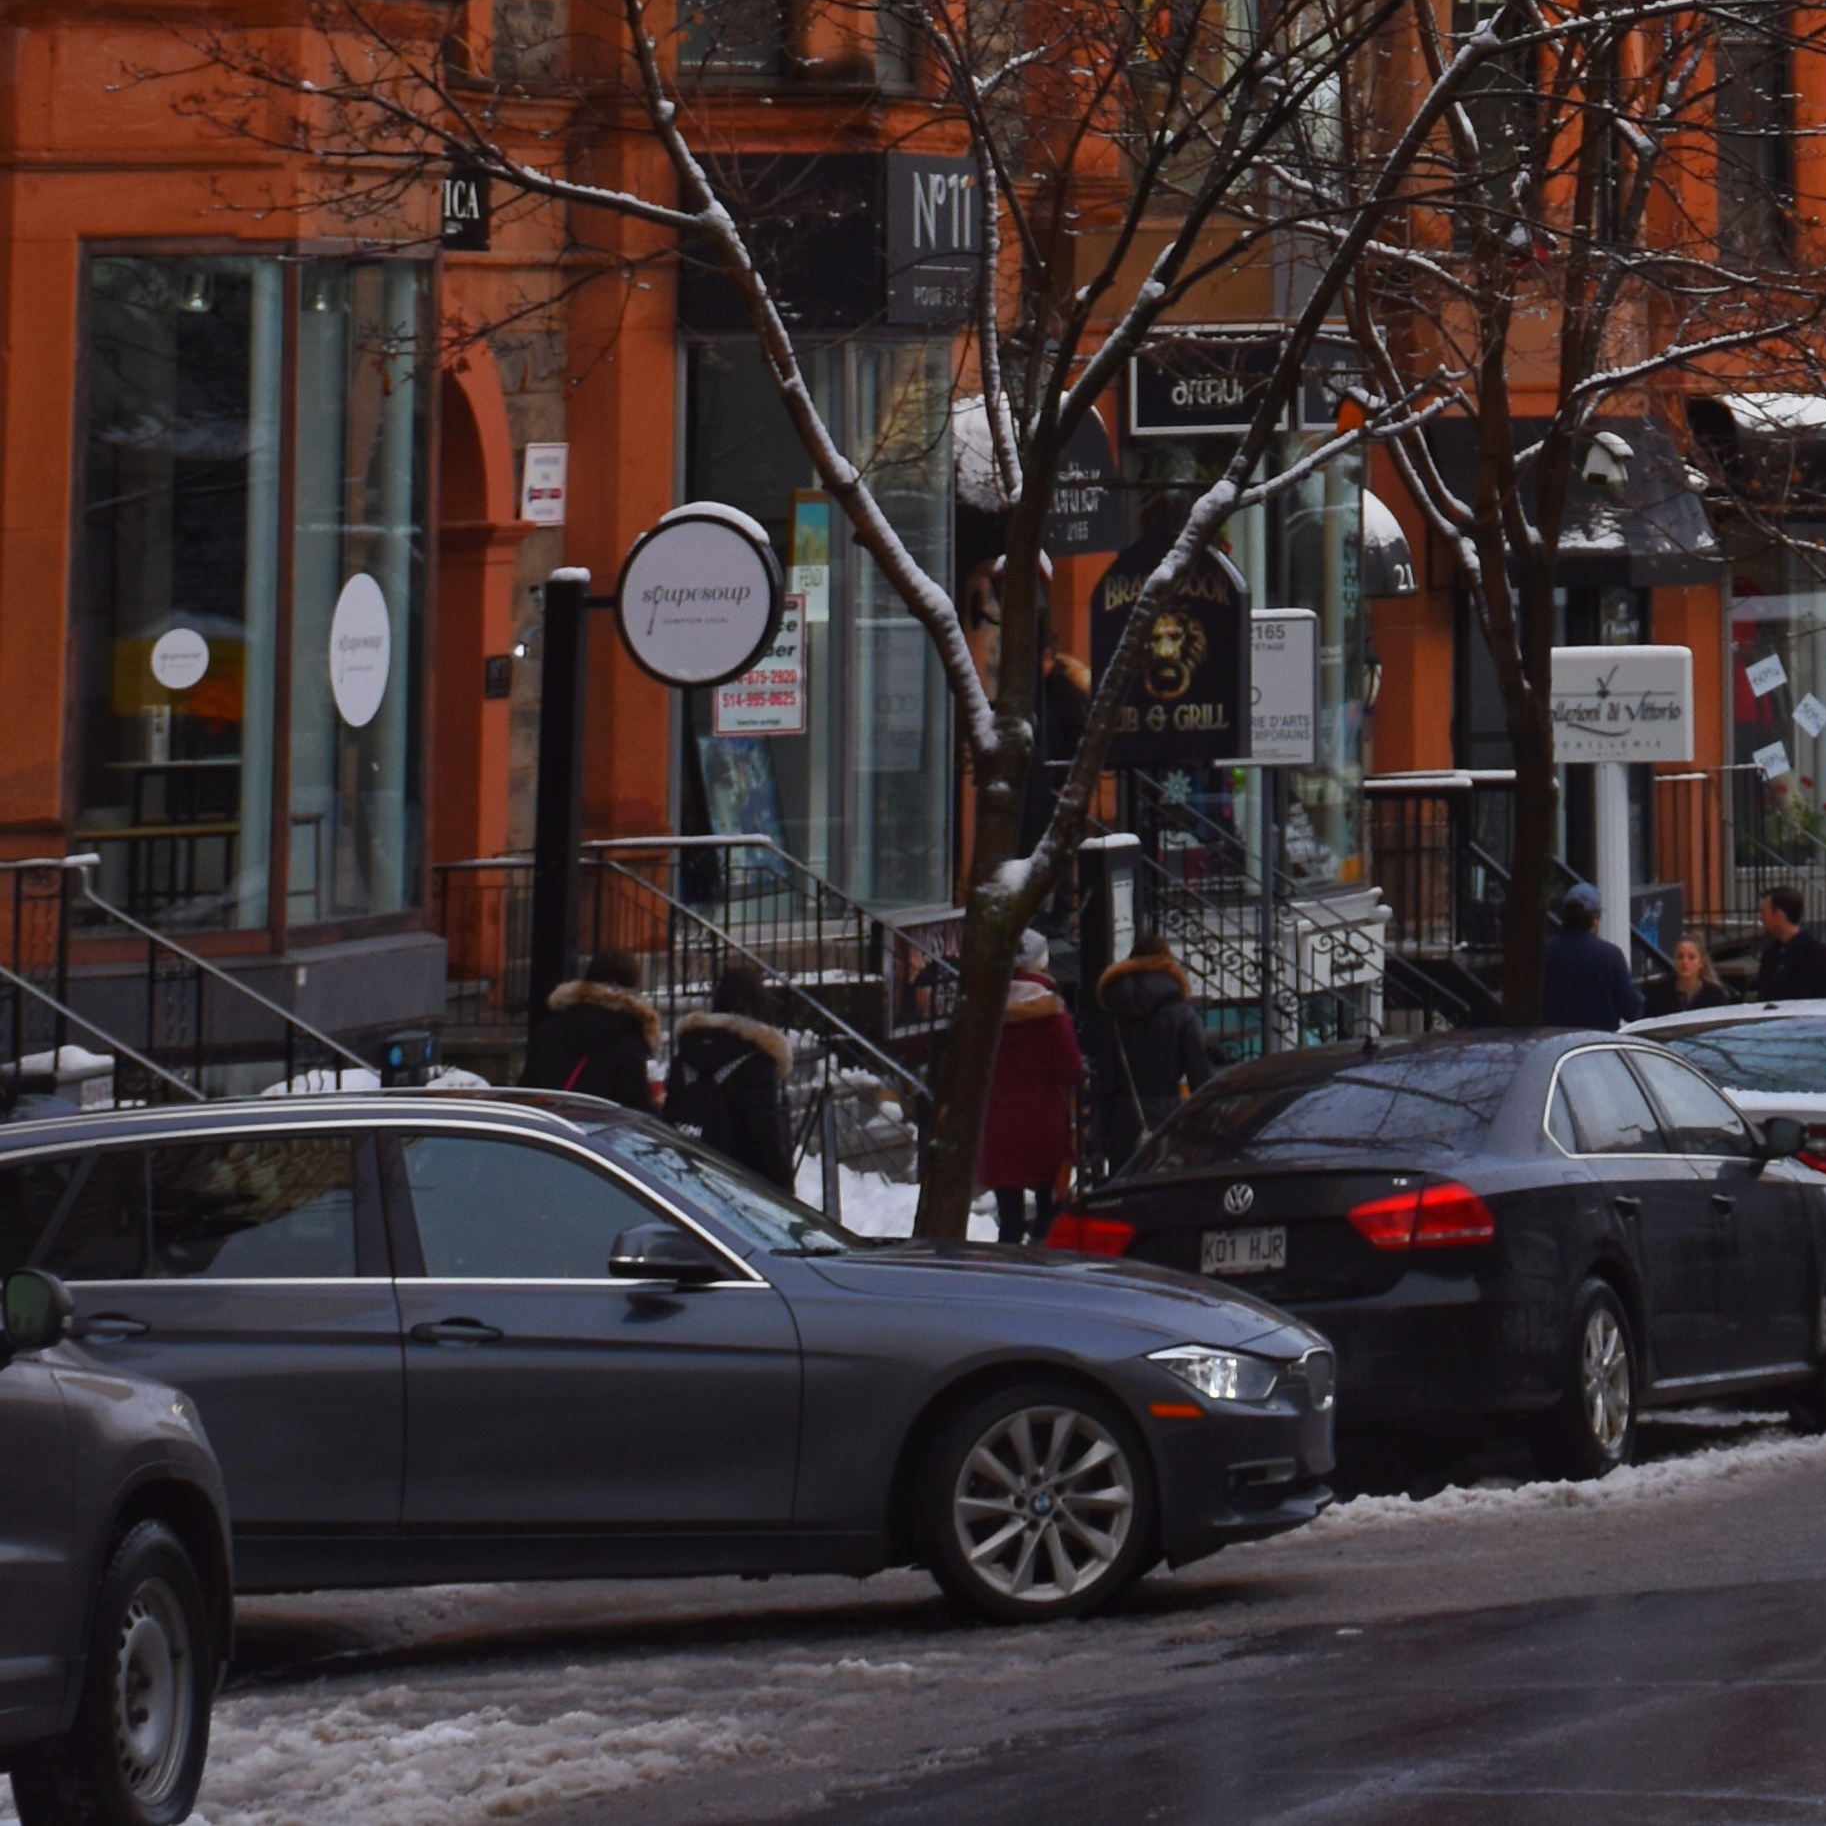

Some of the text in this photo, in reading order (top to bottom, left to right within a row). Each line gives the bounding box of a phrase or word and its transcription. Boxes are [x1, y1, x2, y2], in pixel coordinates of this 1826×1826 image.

[1249, 624, 1285, 640] 165
[1174, 703, 1229, 730] GRILL
[1249, 1235, 1285, 1261] HJR
